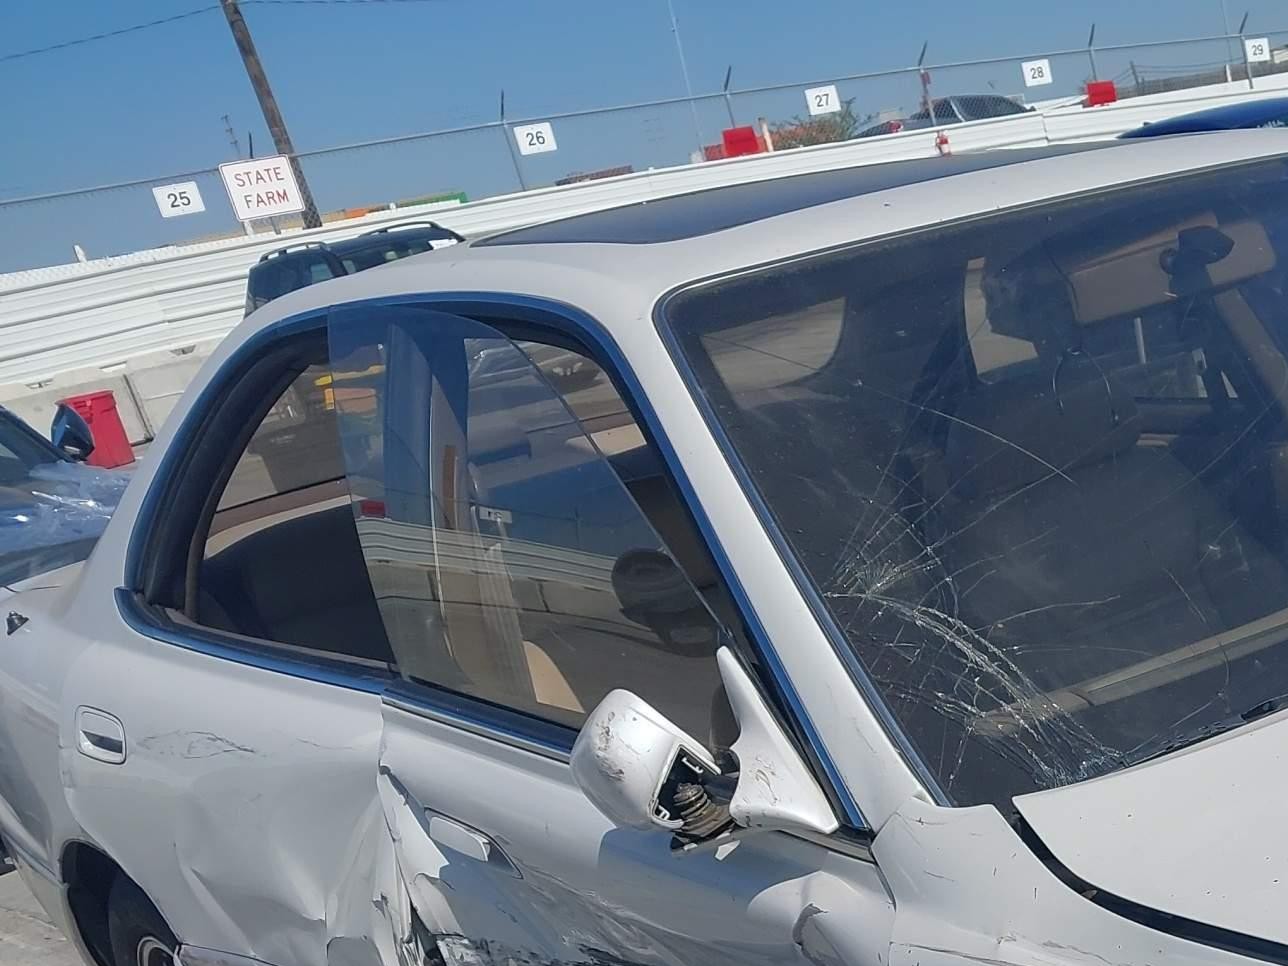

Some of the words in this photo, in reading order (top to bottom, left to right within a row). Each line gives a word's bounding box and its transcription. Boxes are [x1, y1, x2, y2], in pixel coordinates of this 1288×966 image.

[1251, 44, 1264, 56] 29
[1030, 66, 1044, 79] 28
[814, 93, 830, 107] 27
[526, 131, 546, 146] 26
[233, 166, 285, 188] STATE
[167, 191, 191, 208] 25
[243, 189, 289, 209] FARM
